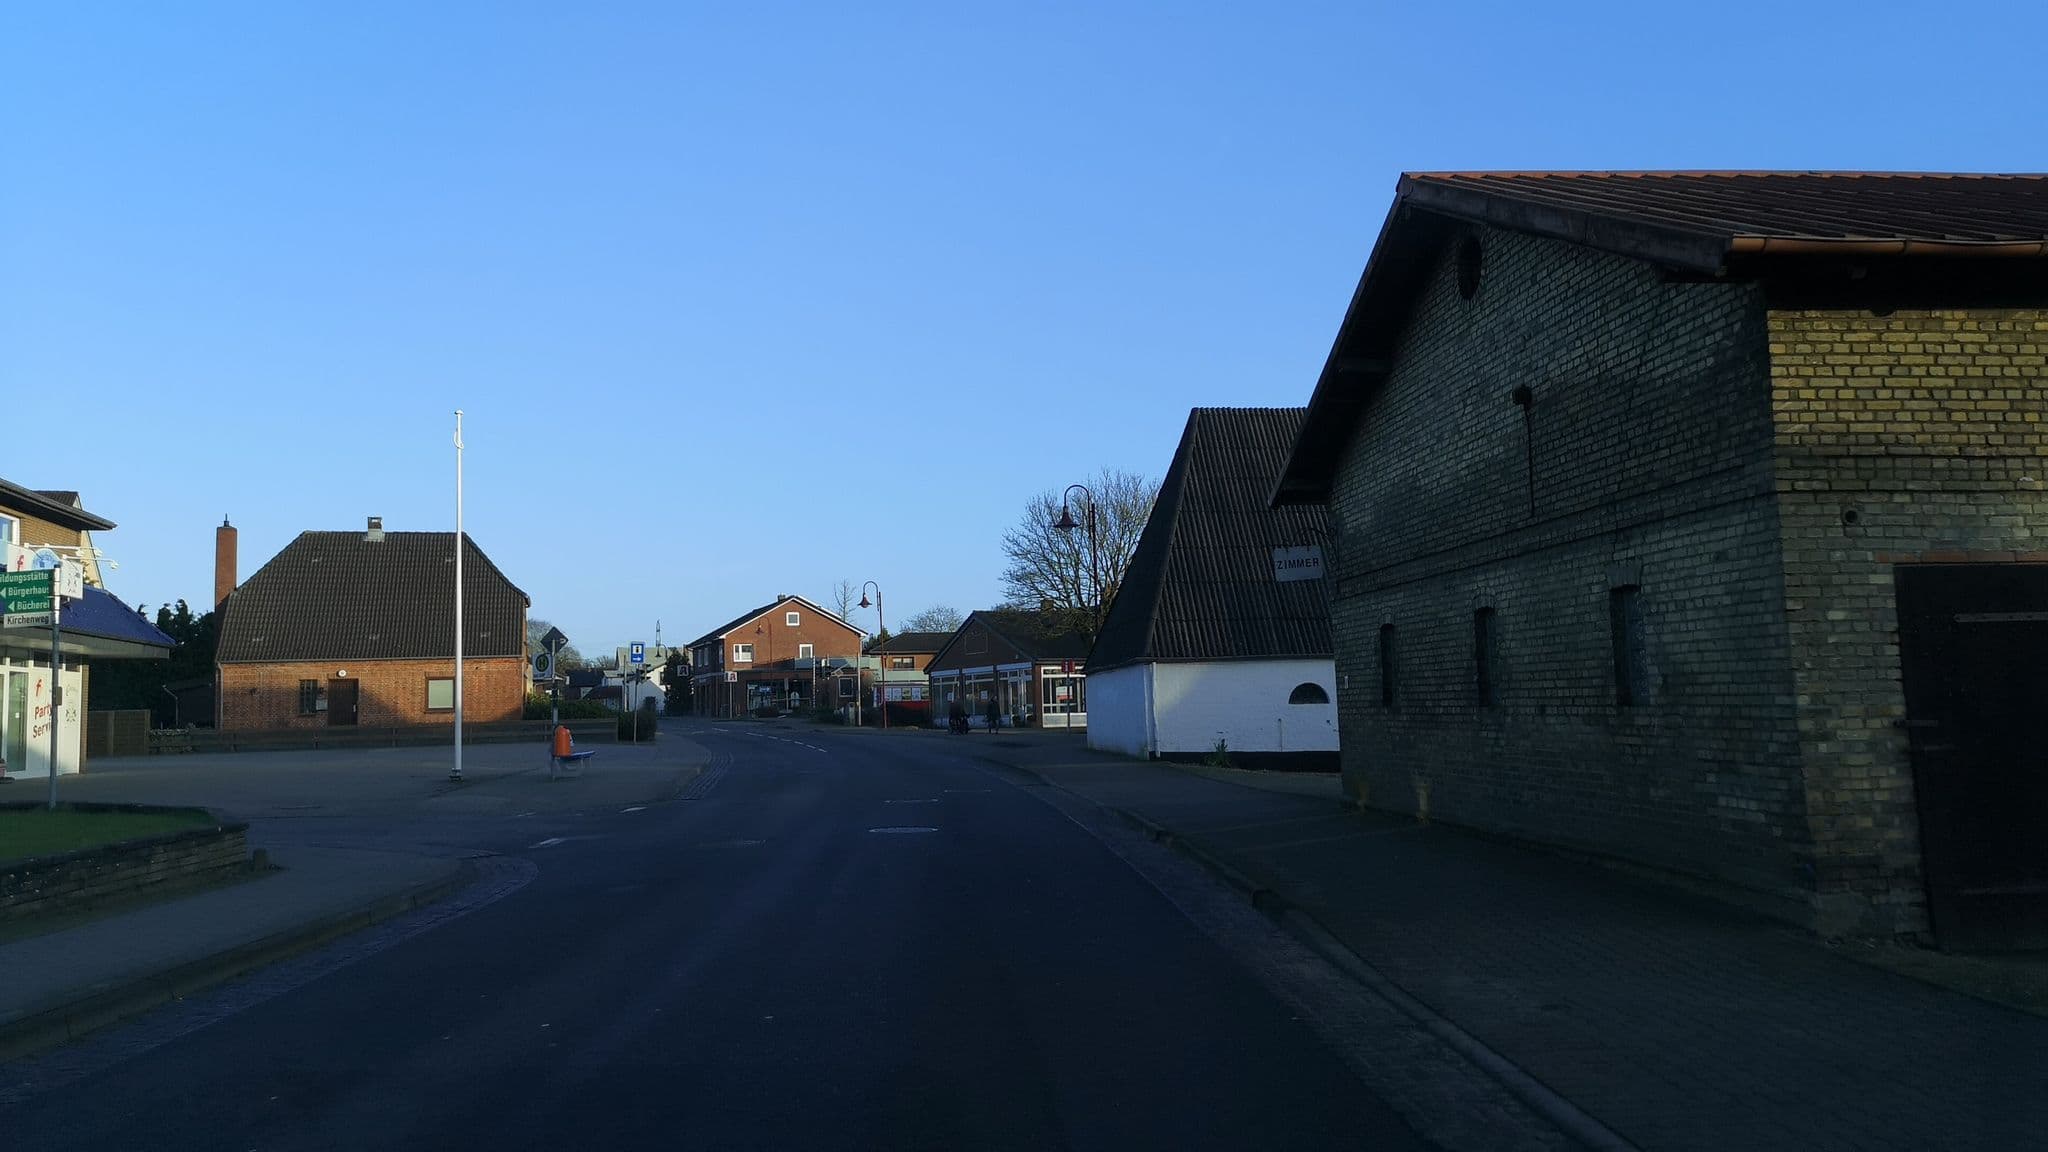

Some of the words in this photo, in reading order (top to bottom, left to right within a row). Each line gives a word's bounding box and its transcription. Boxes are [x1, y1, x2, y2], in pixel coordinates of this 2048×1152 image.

[1277, 558, 1319, 569] ZIMMER
[0, 572, 49, 584] ildungsstätte
[17, 600, 50, 610] Bücherei
[7, 615, 49, 625] Kirchenweg
[33, 721, 51, 738] Servi
